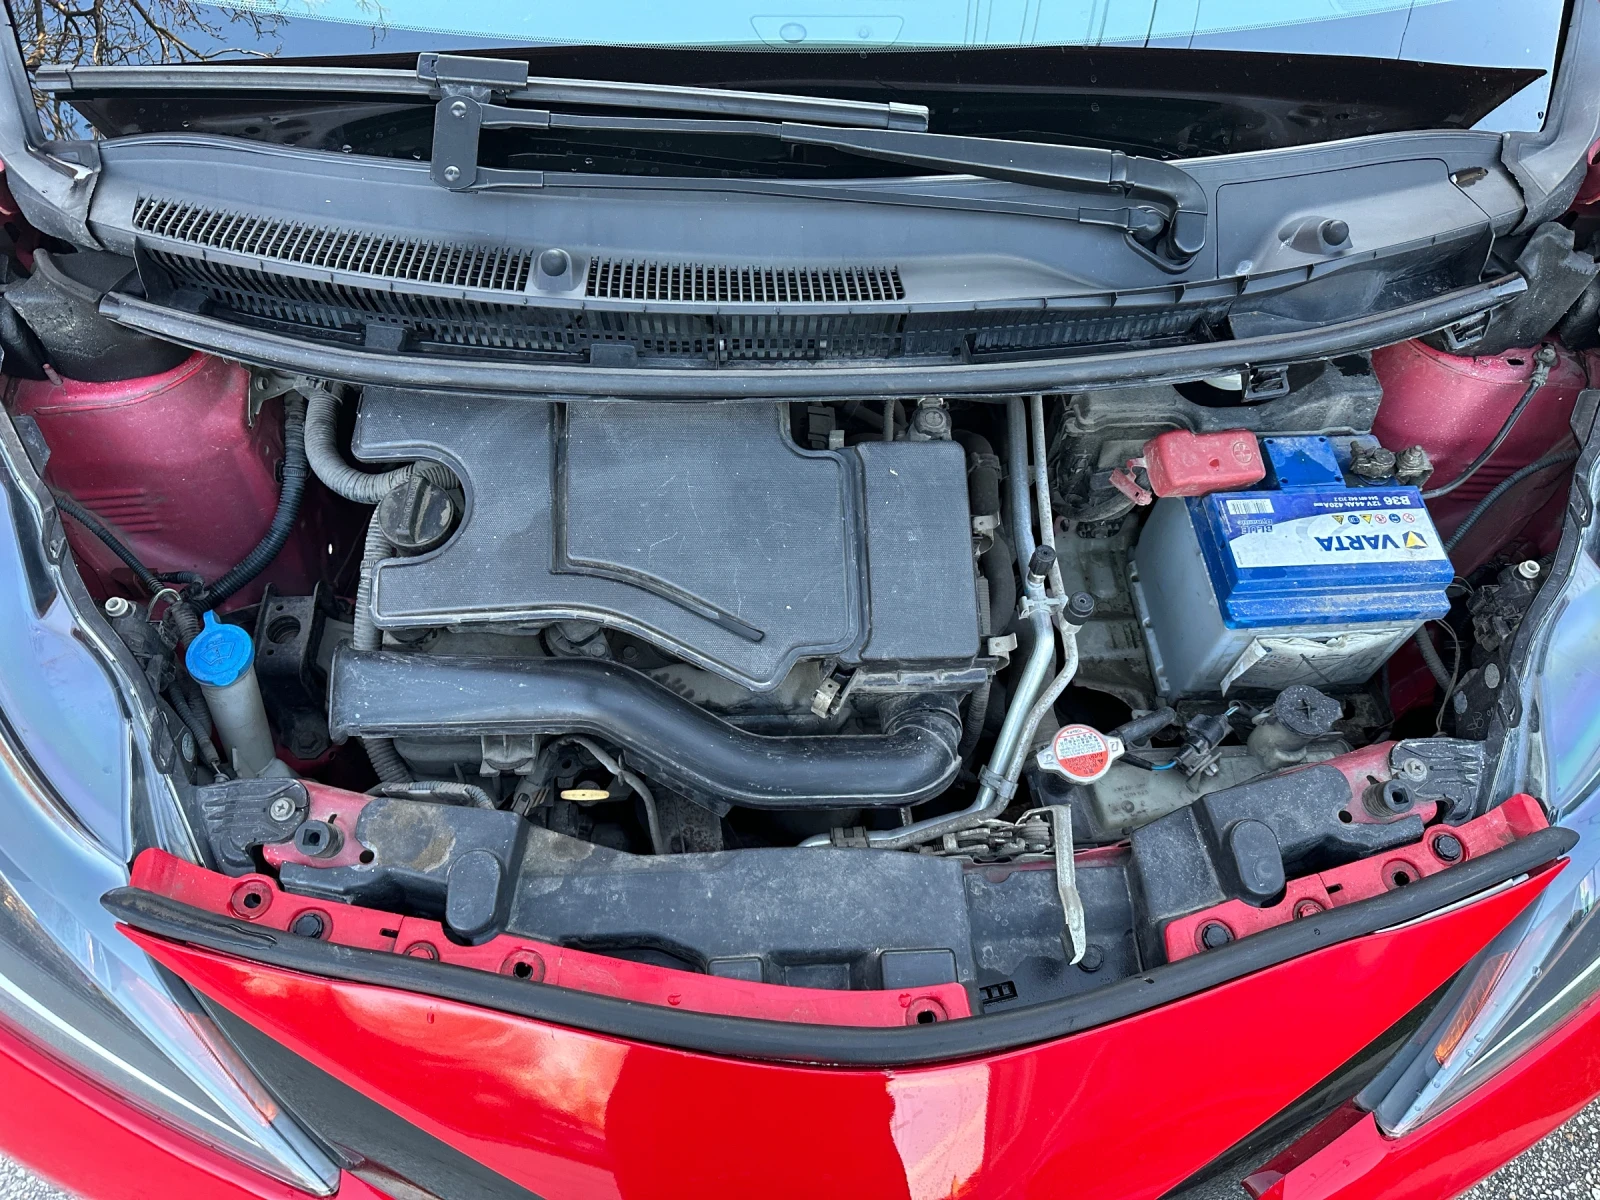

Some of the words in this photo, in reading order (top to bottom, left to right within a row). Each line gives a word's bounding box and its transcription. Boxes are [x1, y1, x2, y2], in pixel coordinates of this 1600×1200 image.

[1383, 495, 1411, 506] B36
[1241, 525, 1273, 534] BLUE
[1314, 534, 1401, 552] VARTA
